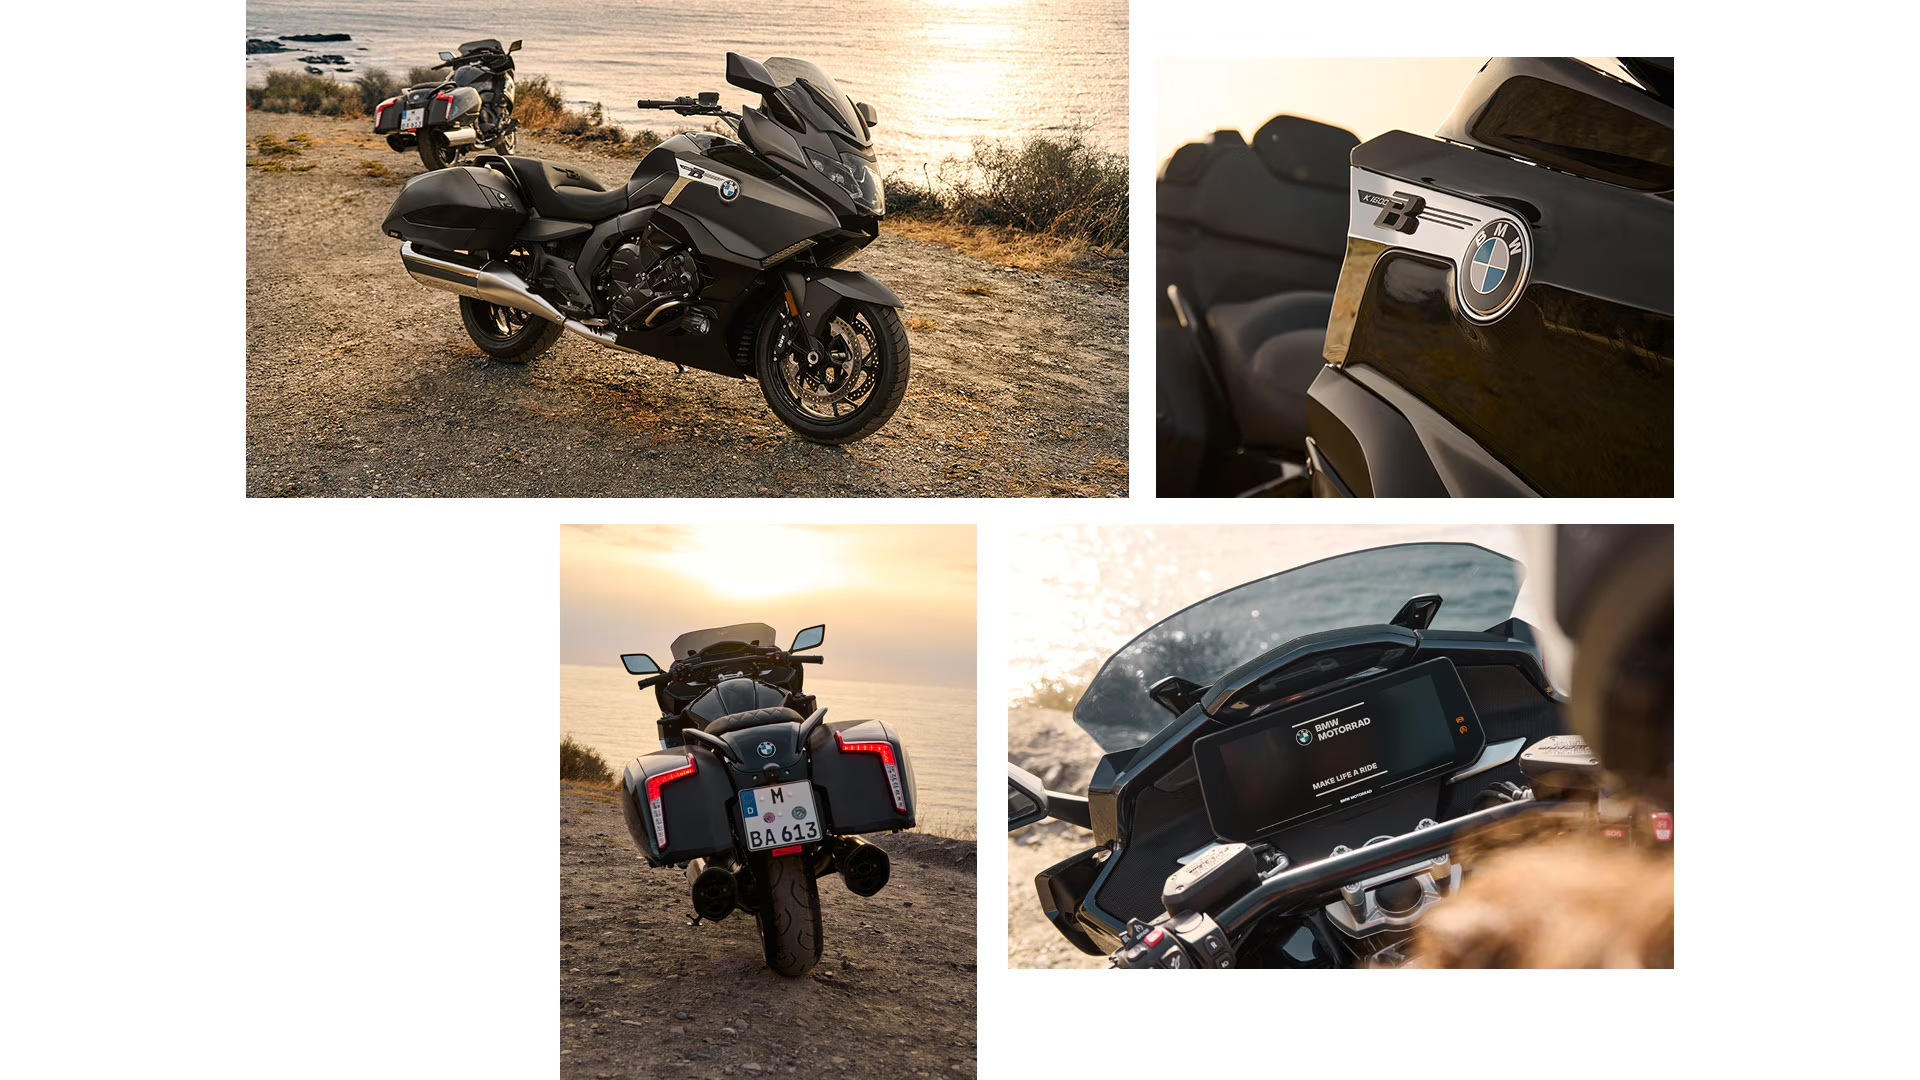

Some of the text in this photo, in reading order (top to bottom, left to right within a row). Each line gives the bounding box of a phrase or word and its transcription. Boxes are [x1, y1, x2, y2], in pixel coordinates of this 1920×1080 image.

[1374, 191, 1426, 235] B
[1475, 223, 1522, 256] BMW
[1315, 718, 1339, 732] BMW
[1317, 717, 1371, 741] MOTORRAD
[1312, 776, 1336, 790] MAKE
[1336, 771, 1352, 782] LIFE
[1359, 762, 1378, 774] RIDE
[770, 787, 784, 804] M
[747, 807, 754, 815] D
[750, 828, 777, 848] BA
[781, 822, 817, 842] 613
